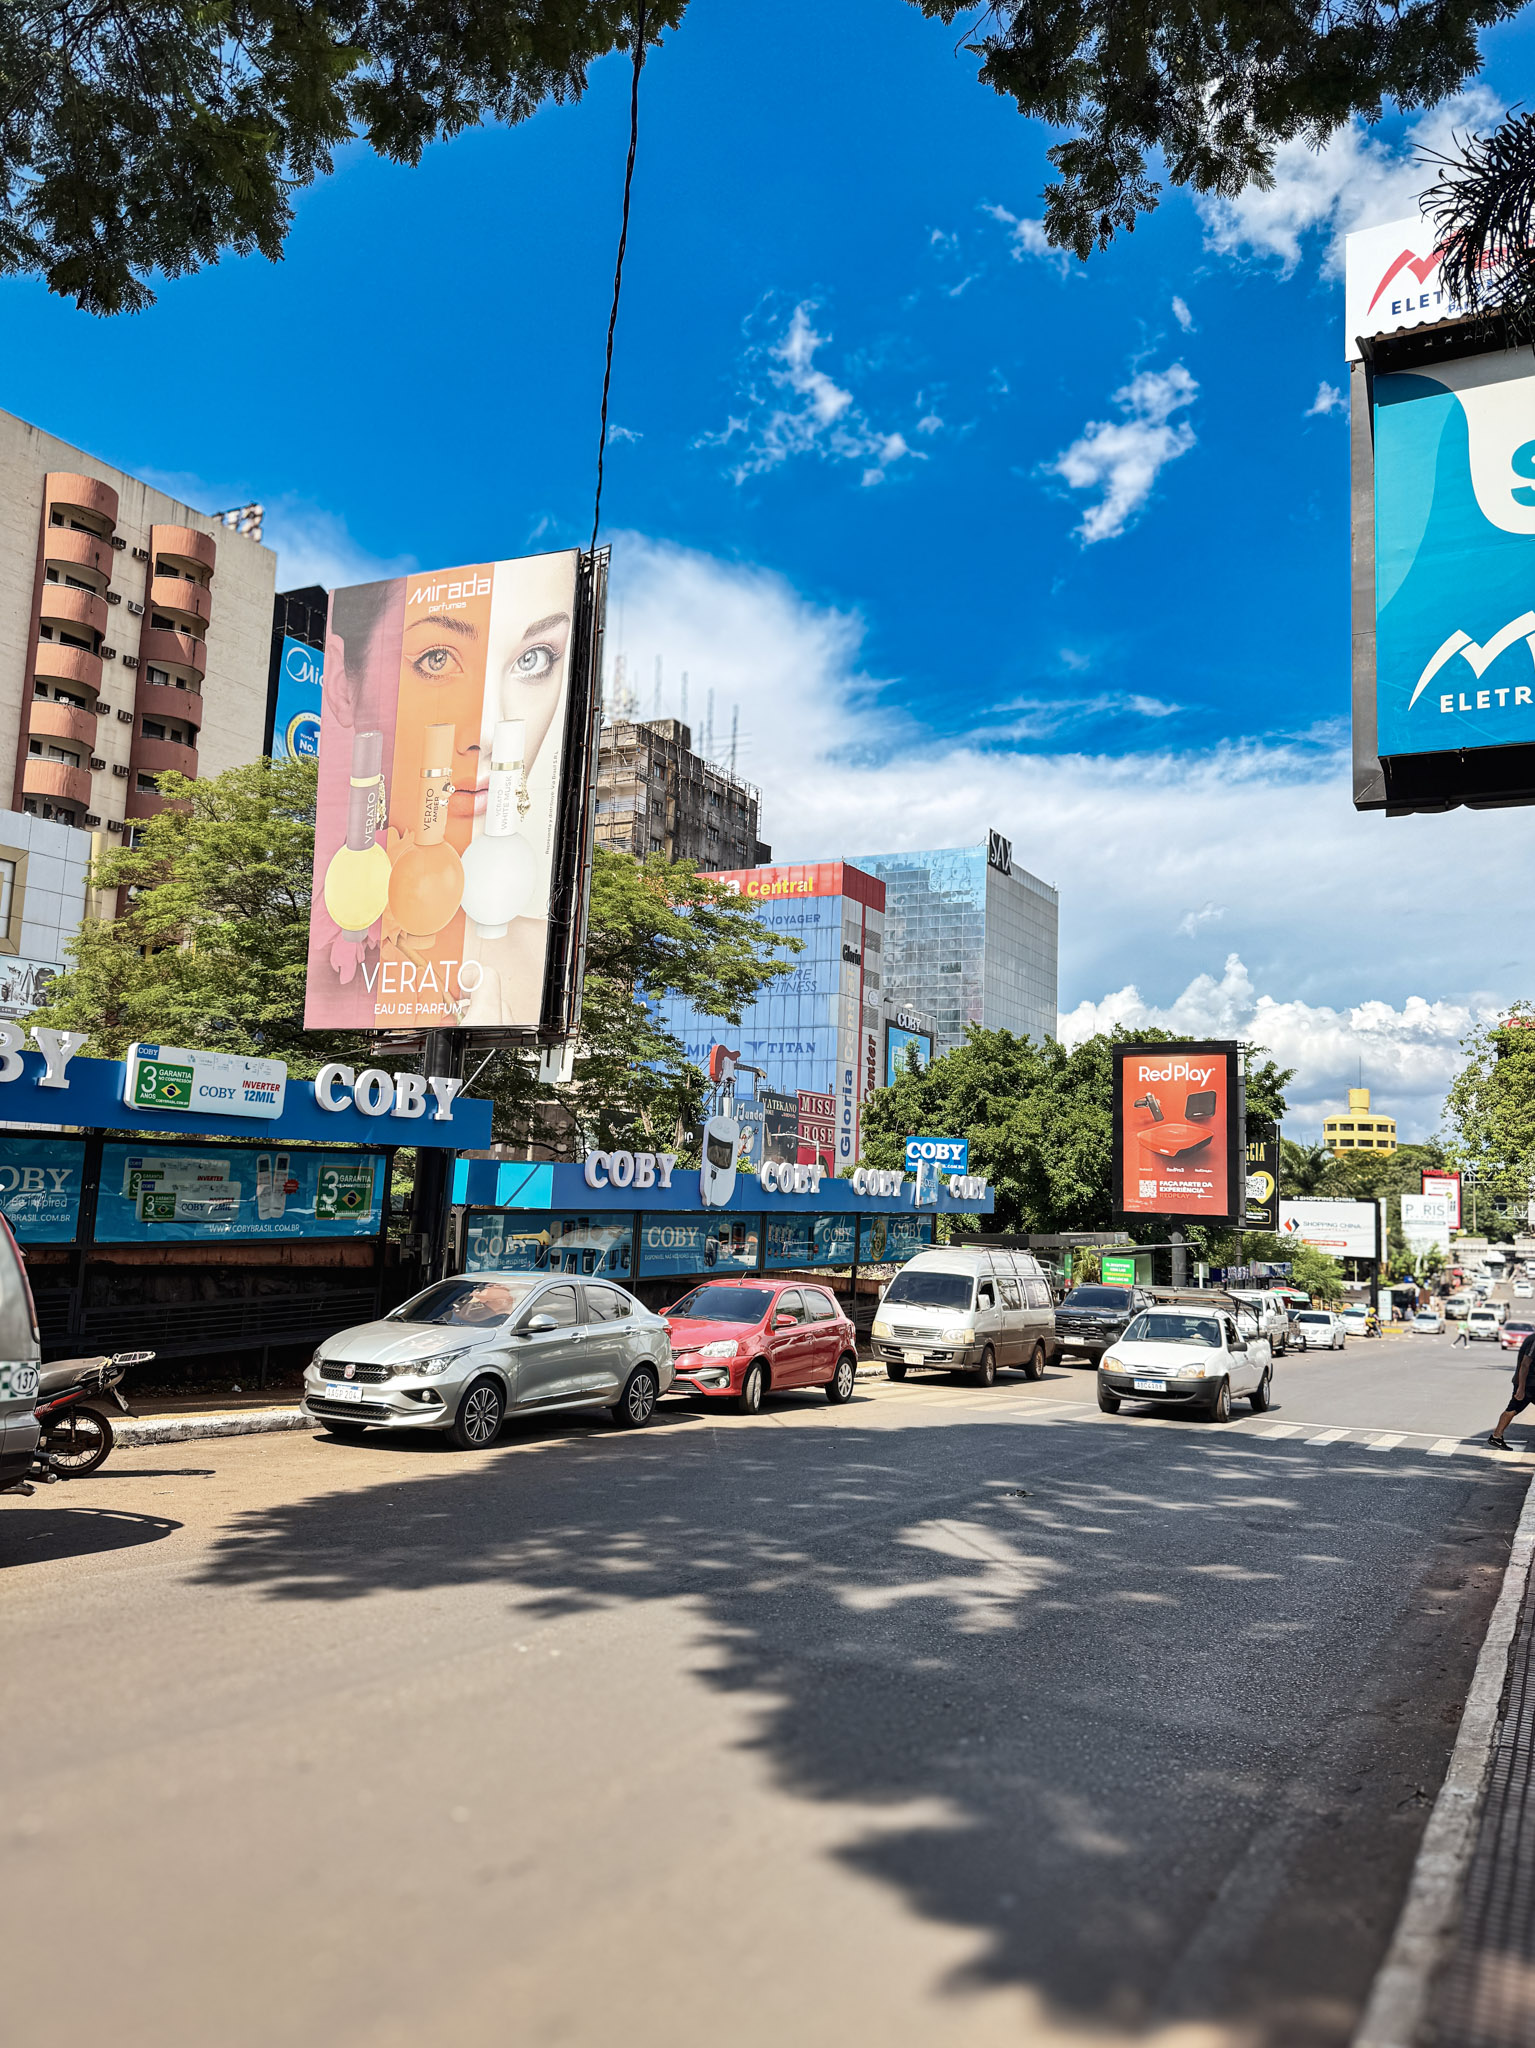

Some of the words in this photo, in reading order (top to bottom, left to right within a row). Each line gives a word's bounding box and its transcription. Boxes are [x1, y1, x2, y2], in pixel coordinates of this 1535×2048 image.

[408, 573, 491, 605] Mirada
[429, 601, 467, 614] perfumes
[364, 792, 376, 844] VERATO
[423, 788, 434, 831] VERATO
[990, 830, 1013, 879] SAX
[747, 876, 813, 897] Central
[768, 913, 821, 926] VOYAGER
[361, 960, 484, 994] VERATO
[768, 980, 818, 993] FITNESS
[374, 1003, 396, 1015] EAU
[397, 1003, 413, 1014] DE
[415, 1003, 462, 1014] PARFUM
[897, 1012, 922, 1033] COBY
[138, 1047, 160, 1056] COBY
[767, 1041, 817, 1054] TITAN
[141, 1065, 157, 1093] 3
[159, 1069, 192, 1079] GARANTIA
[199, 1085, 236, 1099] COBY
[242, 1080, 281, 1092] INVERTER
[315, 1063, 463, 1121] COBY
[243, 1089, 276, 1104] 12MIL
[840, 1069, 853, 1158] Gloria
[803, 1125, 833, 1144] ROSE
[907, 1142, 965, 1160] COBY
[339, 1174, 372, 1183] GARANTIA
[585, 1150, 678, 1188] COBY
[760, 1160, 824, 1194] COBY
[322, 1171, 338, 1205] 3
[853, 1167, 905, 1197] COBY
[950, 1174, 988, 1199] COBY
[145, 1195, 155, 1213] 3
[181, 1203, 205, 1212] COBY
[647, 1226, 699, 1248] COBY
[893, 1222, 923, 1240] COBY
[17, 1371, 35, 1391] 137
